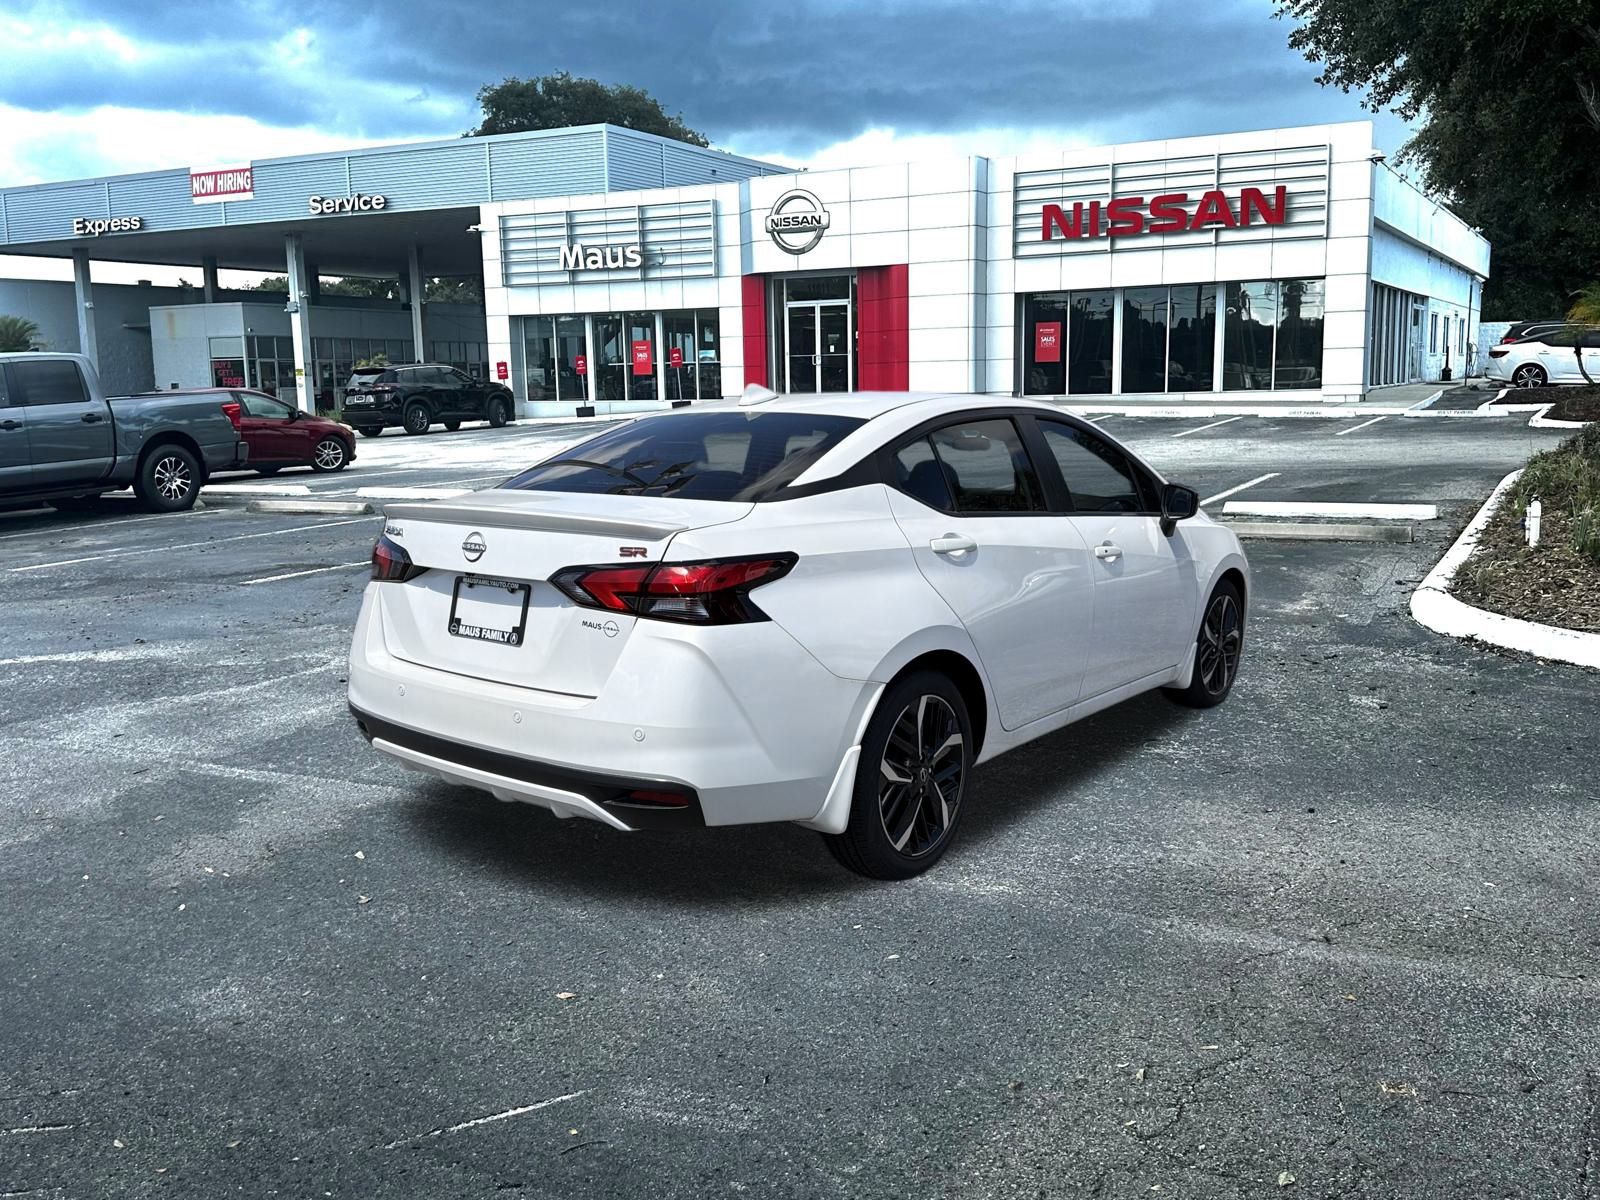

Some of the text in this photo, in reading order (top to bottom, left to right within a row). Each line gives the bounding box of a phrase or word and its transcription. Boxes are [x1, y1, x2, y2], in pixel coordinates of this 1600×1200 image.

[192, 171, 251, 195] NOW HIRING
[309, 193, 385, 214] Service
[1042, 185, 1287, 241] NISSAN
[73, 216, 141, 237] Express
[770, 215, 821, 228] NISSAN
[559, 243, 642, 270] Maus
[223, 377, 244, 386] FREE
[463, 542, 486, 552] NISSAN
[619, 546, 648, 558] SR
[463, 577, 519, 589] MAUSFAMILYAUTO.COM
[581, 620, 602, 630] MAUS
[458, 625, 510, 642] MAUS FAMILY
